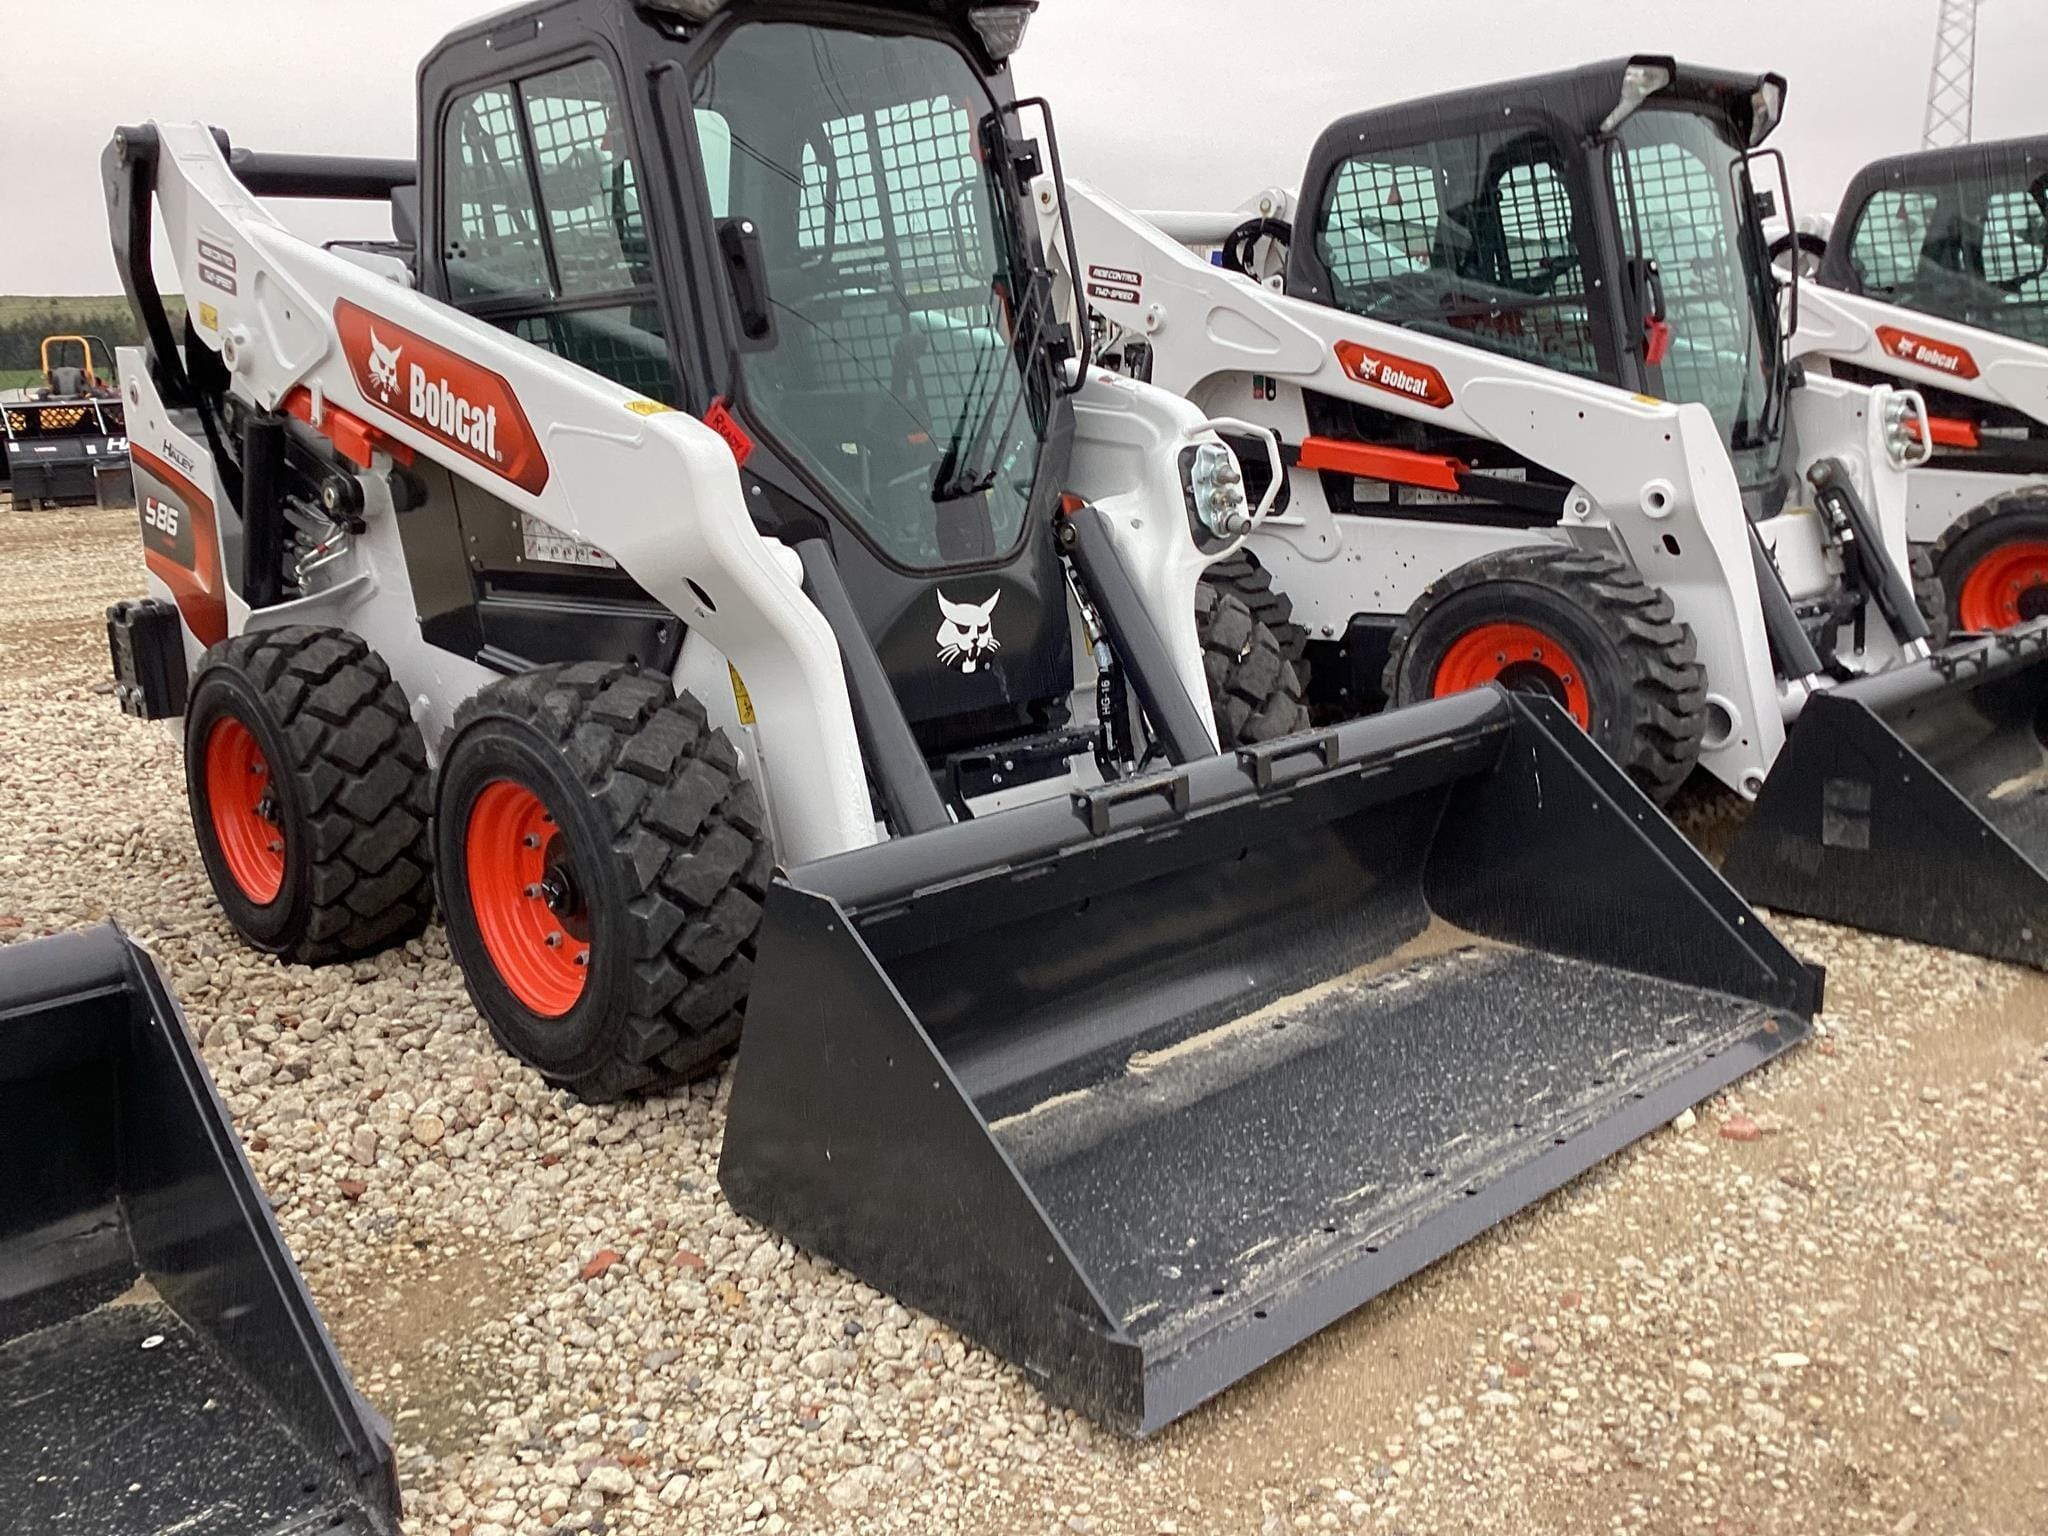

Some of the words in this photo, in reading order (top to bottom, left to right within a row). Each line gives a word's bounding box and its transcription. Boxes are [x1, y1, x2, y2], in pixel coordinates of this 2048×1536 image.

[1916, 345, 1959, 371] Bobcat
[1381, 365, 1428, 397] Bobcat
[410, 362, 497, 460] Bobcat
[163, 439, 195, 472] HALEY
[145, 497, 179, 536] S86
[1101, 680, 1111, 715] HG-16
